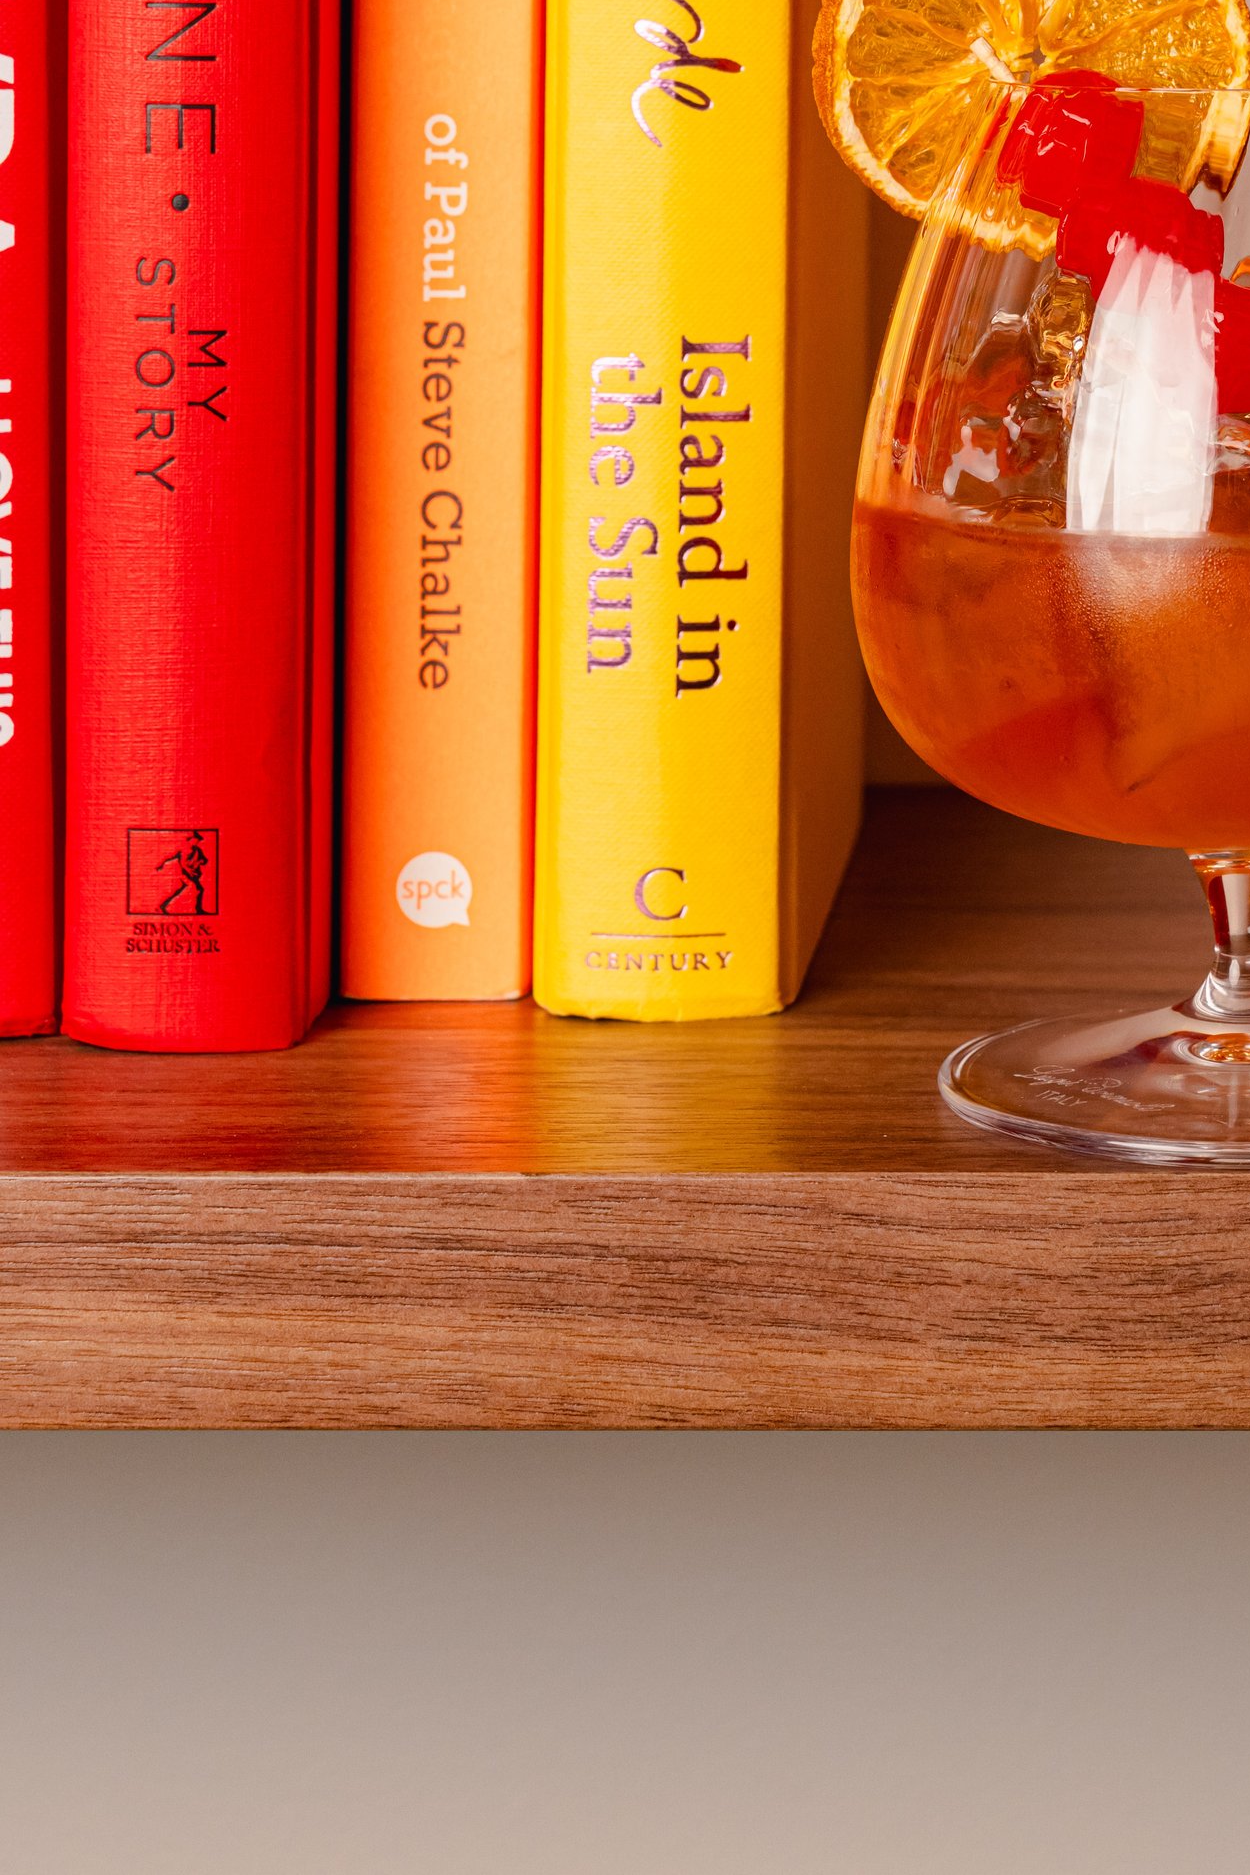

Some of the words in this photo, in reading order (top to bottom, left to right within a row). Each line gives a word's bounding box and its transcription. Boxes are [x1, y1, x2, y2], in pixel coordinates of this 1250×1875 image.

[424, 114, 466, 169] of
[423, 183, 466, 300] Paul
[136, 257, 176, 493] STORY
[187, 329, 227, 421] MY
[421, 323, 466, 472] Steve
[589, 351, 662, 489] the
[680, 334, 753, 587] Island
[420, 491, 464, 690] Chalke
[587, 516, 660, 674] Sun
[675, 613, 740, 698] in
[134, 923, 192, 935] SIMON
[198, 924, 213, 935] &
[403, 869, 464, 910] spck
[127, 939, 220, 954] SCHUSTER
[585, 950, 734, 972] CENTURY
[1035, 1089, 1088, 1107] ITALY
